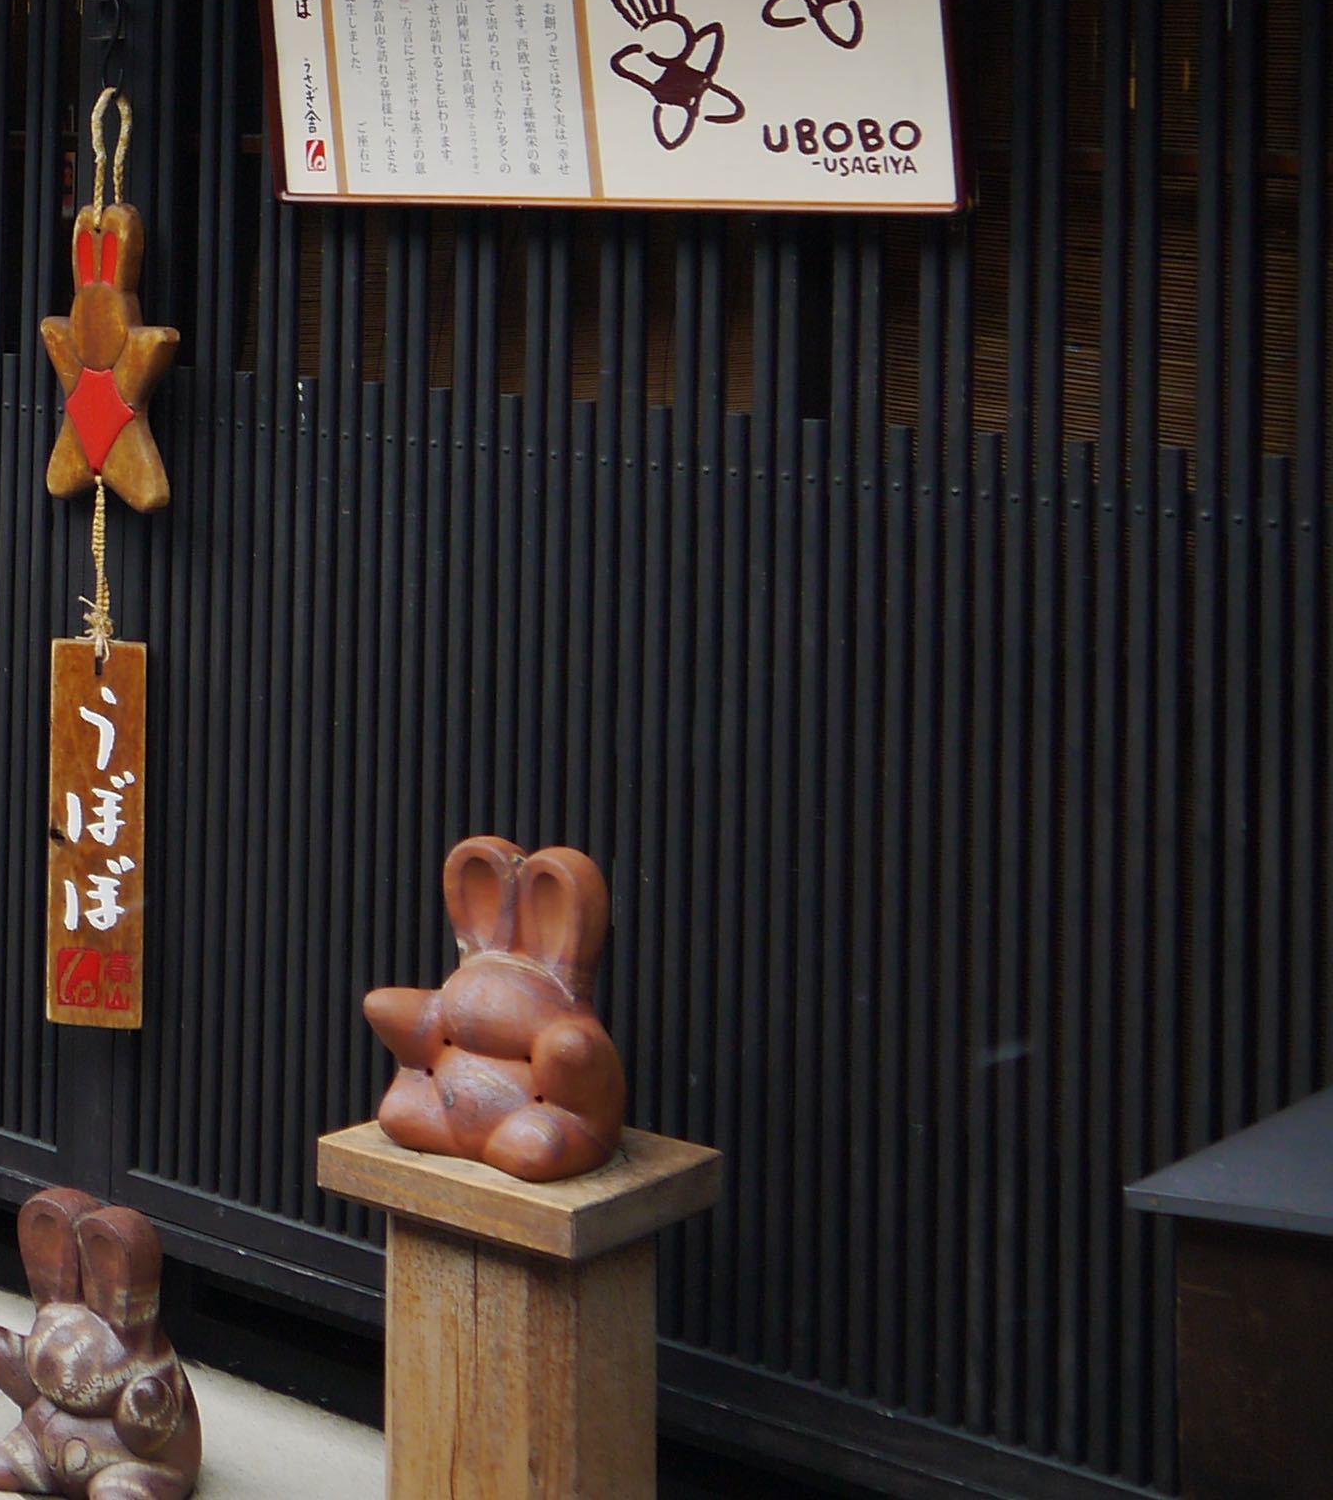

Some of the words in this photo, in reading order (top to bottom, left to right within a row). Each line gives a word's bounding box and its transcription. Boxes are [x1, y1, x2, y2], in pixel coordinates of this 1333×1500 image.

[762, 118, 923, 156] UBOBO
[64, 686, 137, 932] うぼぼ
